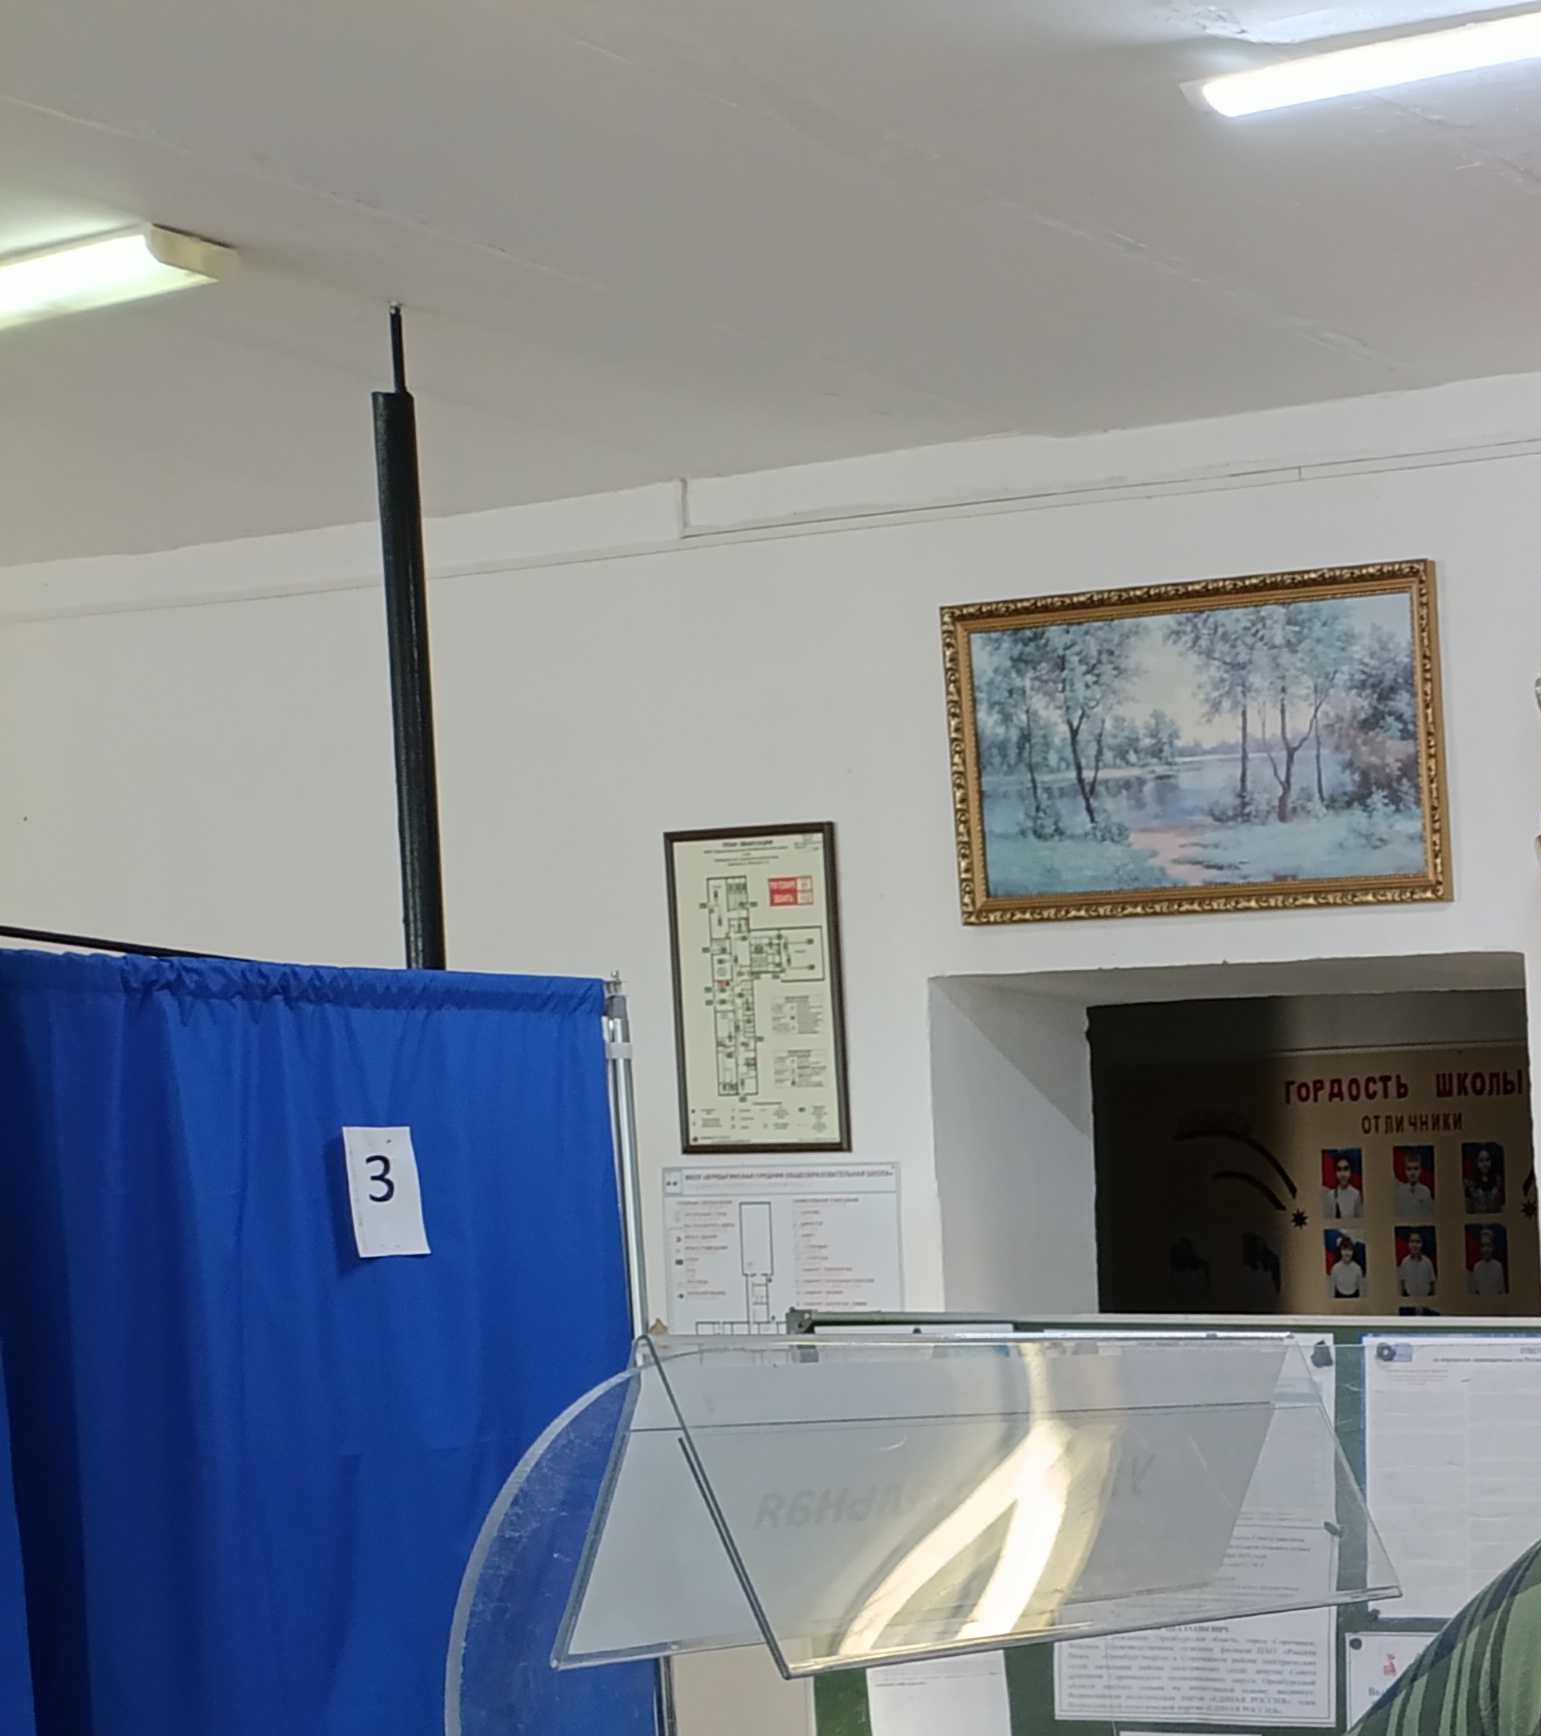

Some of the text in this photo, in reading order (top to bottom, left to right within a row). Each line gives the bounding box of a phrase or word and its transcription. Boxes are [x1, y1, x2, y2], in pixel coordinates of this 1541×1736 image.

[1285, 1070, 1523, 1104] ГОРДОСТЬ ШКОЛЫ
[1361, 1113, 1463, 1135] ОТЛИЧНИКИ
[366, 1155, 394, 1203] 3
